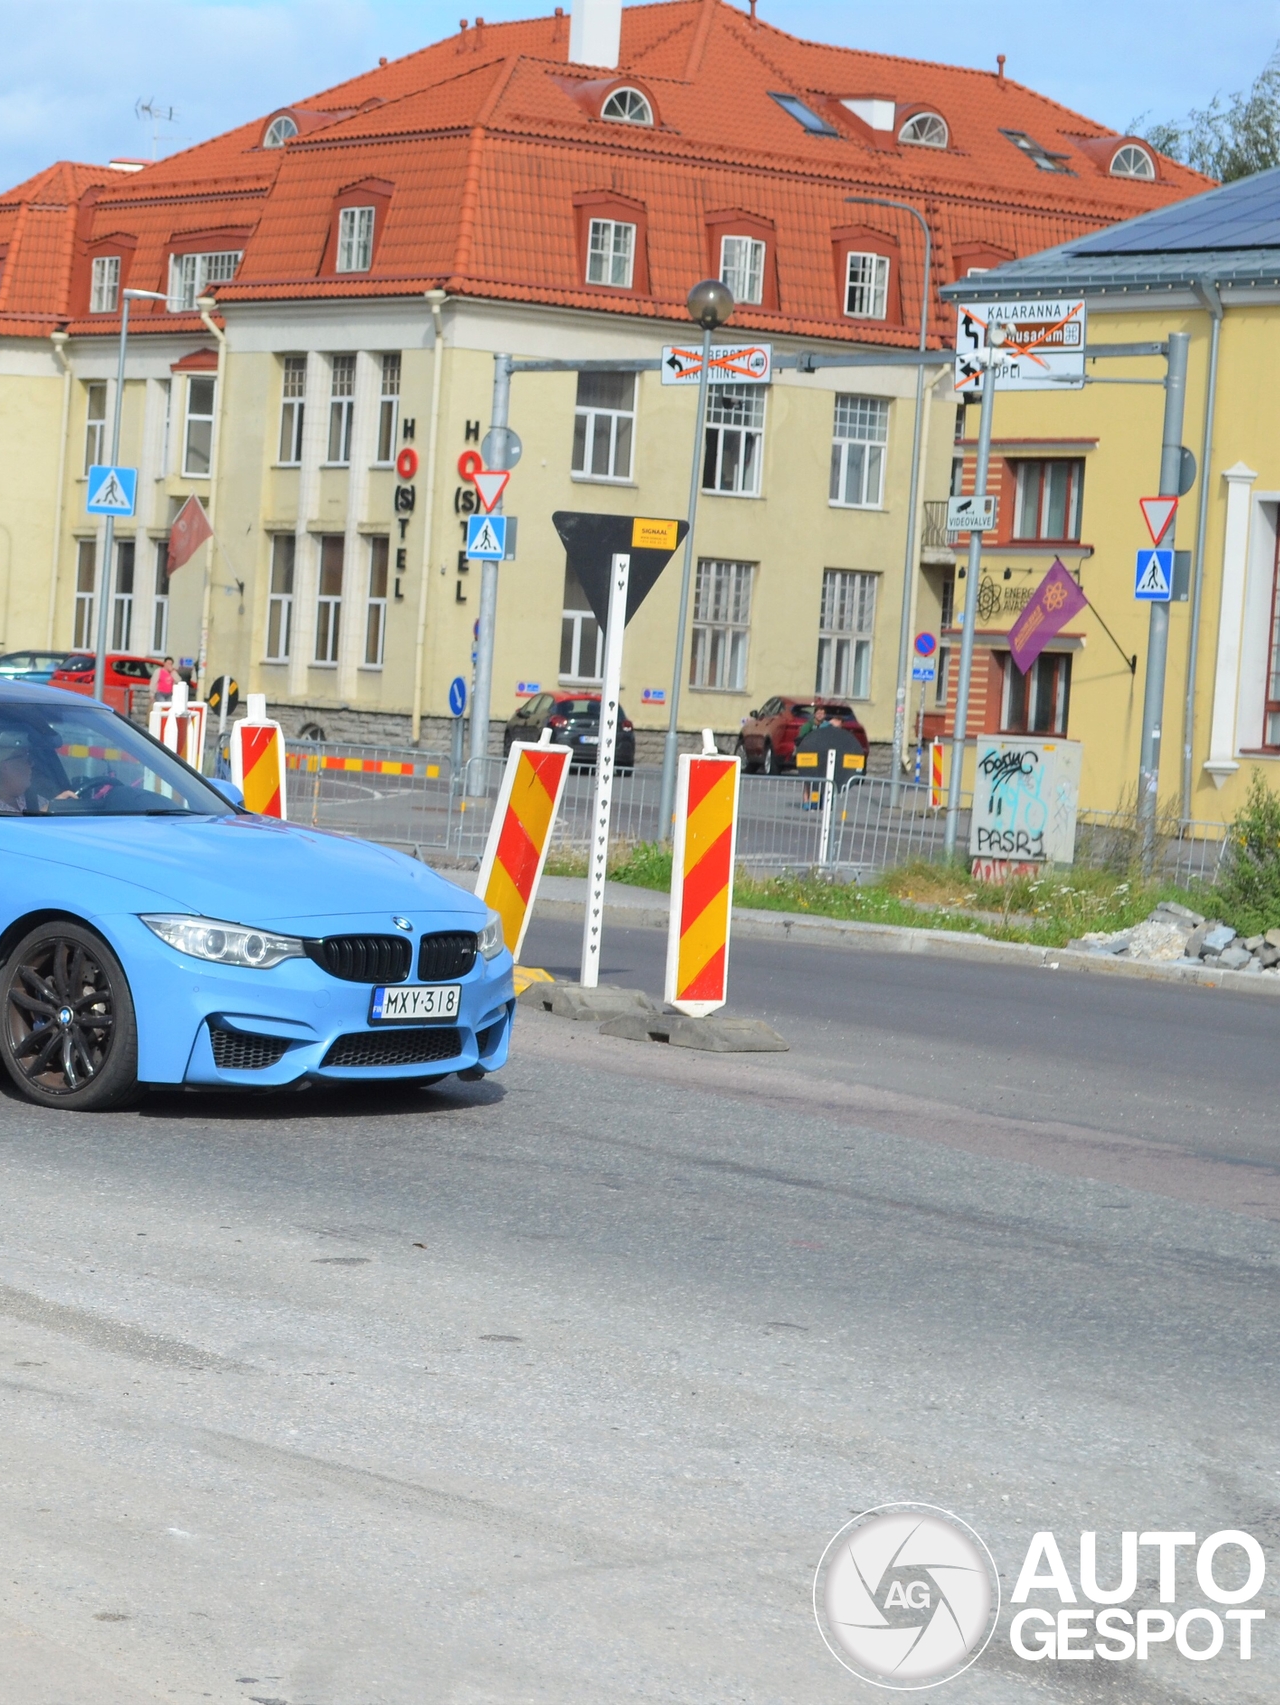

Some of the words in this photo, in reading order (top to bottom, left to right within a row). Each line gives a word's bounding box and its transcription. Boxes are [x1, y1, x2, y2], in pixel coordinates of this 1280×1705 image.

[987, 304, 1061, 319] KALARANNA
[949, 516, 991, 527] VIDEOVALVE
[1004, 587, 1034, 599] ENERG
